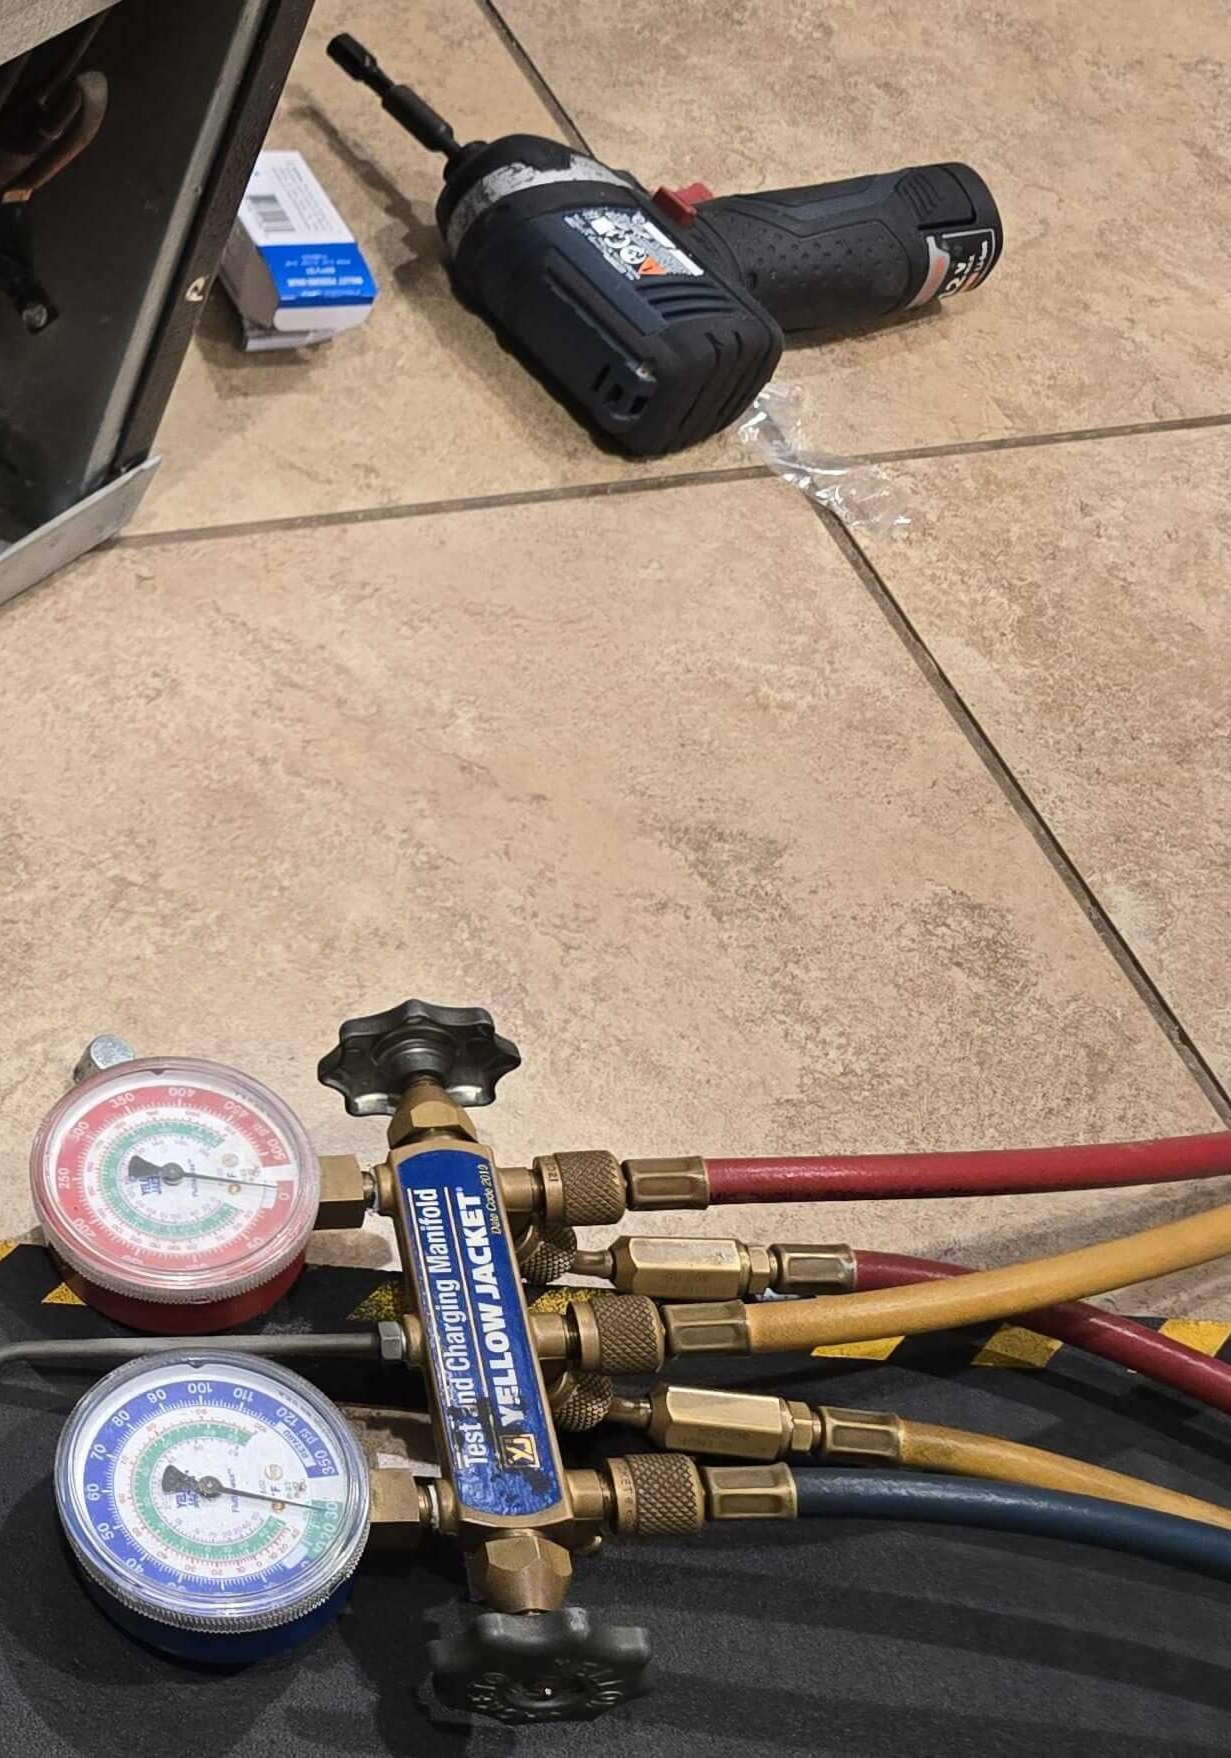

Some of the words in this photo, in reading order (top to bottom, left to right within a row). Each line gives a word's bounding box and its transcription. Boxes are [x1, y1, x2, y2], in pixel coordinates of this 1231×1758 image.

[58, 1167, 70, 1189] 250
[484, 1189, 497, 1212] Code
[413, 1188, 453, 1273] Manifold
[491, 1214, 502, 1235] Date
[435, 1279, 471, 1371] Charging
[478, 1302, 525, 1427] YELLOW
[146, 1388, 167, 1403] 90
[188, 1383, 213, 1394] 100
[233, 1387, 254, 1402] 110
[111, 1409, 131, 1428] 80
[276, 1407, 298, 1426] 120
[90, 1443, 107, 1461] 70
[459, 1422, 488, 1468] Test
[314, 1449, 335, 1475] 350
[87, 1483, 100, 1501] 60
[325, 1501, 338, 1520] 30
[97, 1522, 115, 1541] 50
[323, 1523, 337, 1540] 20
